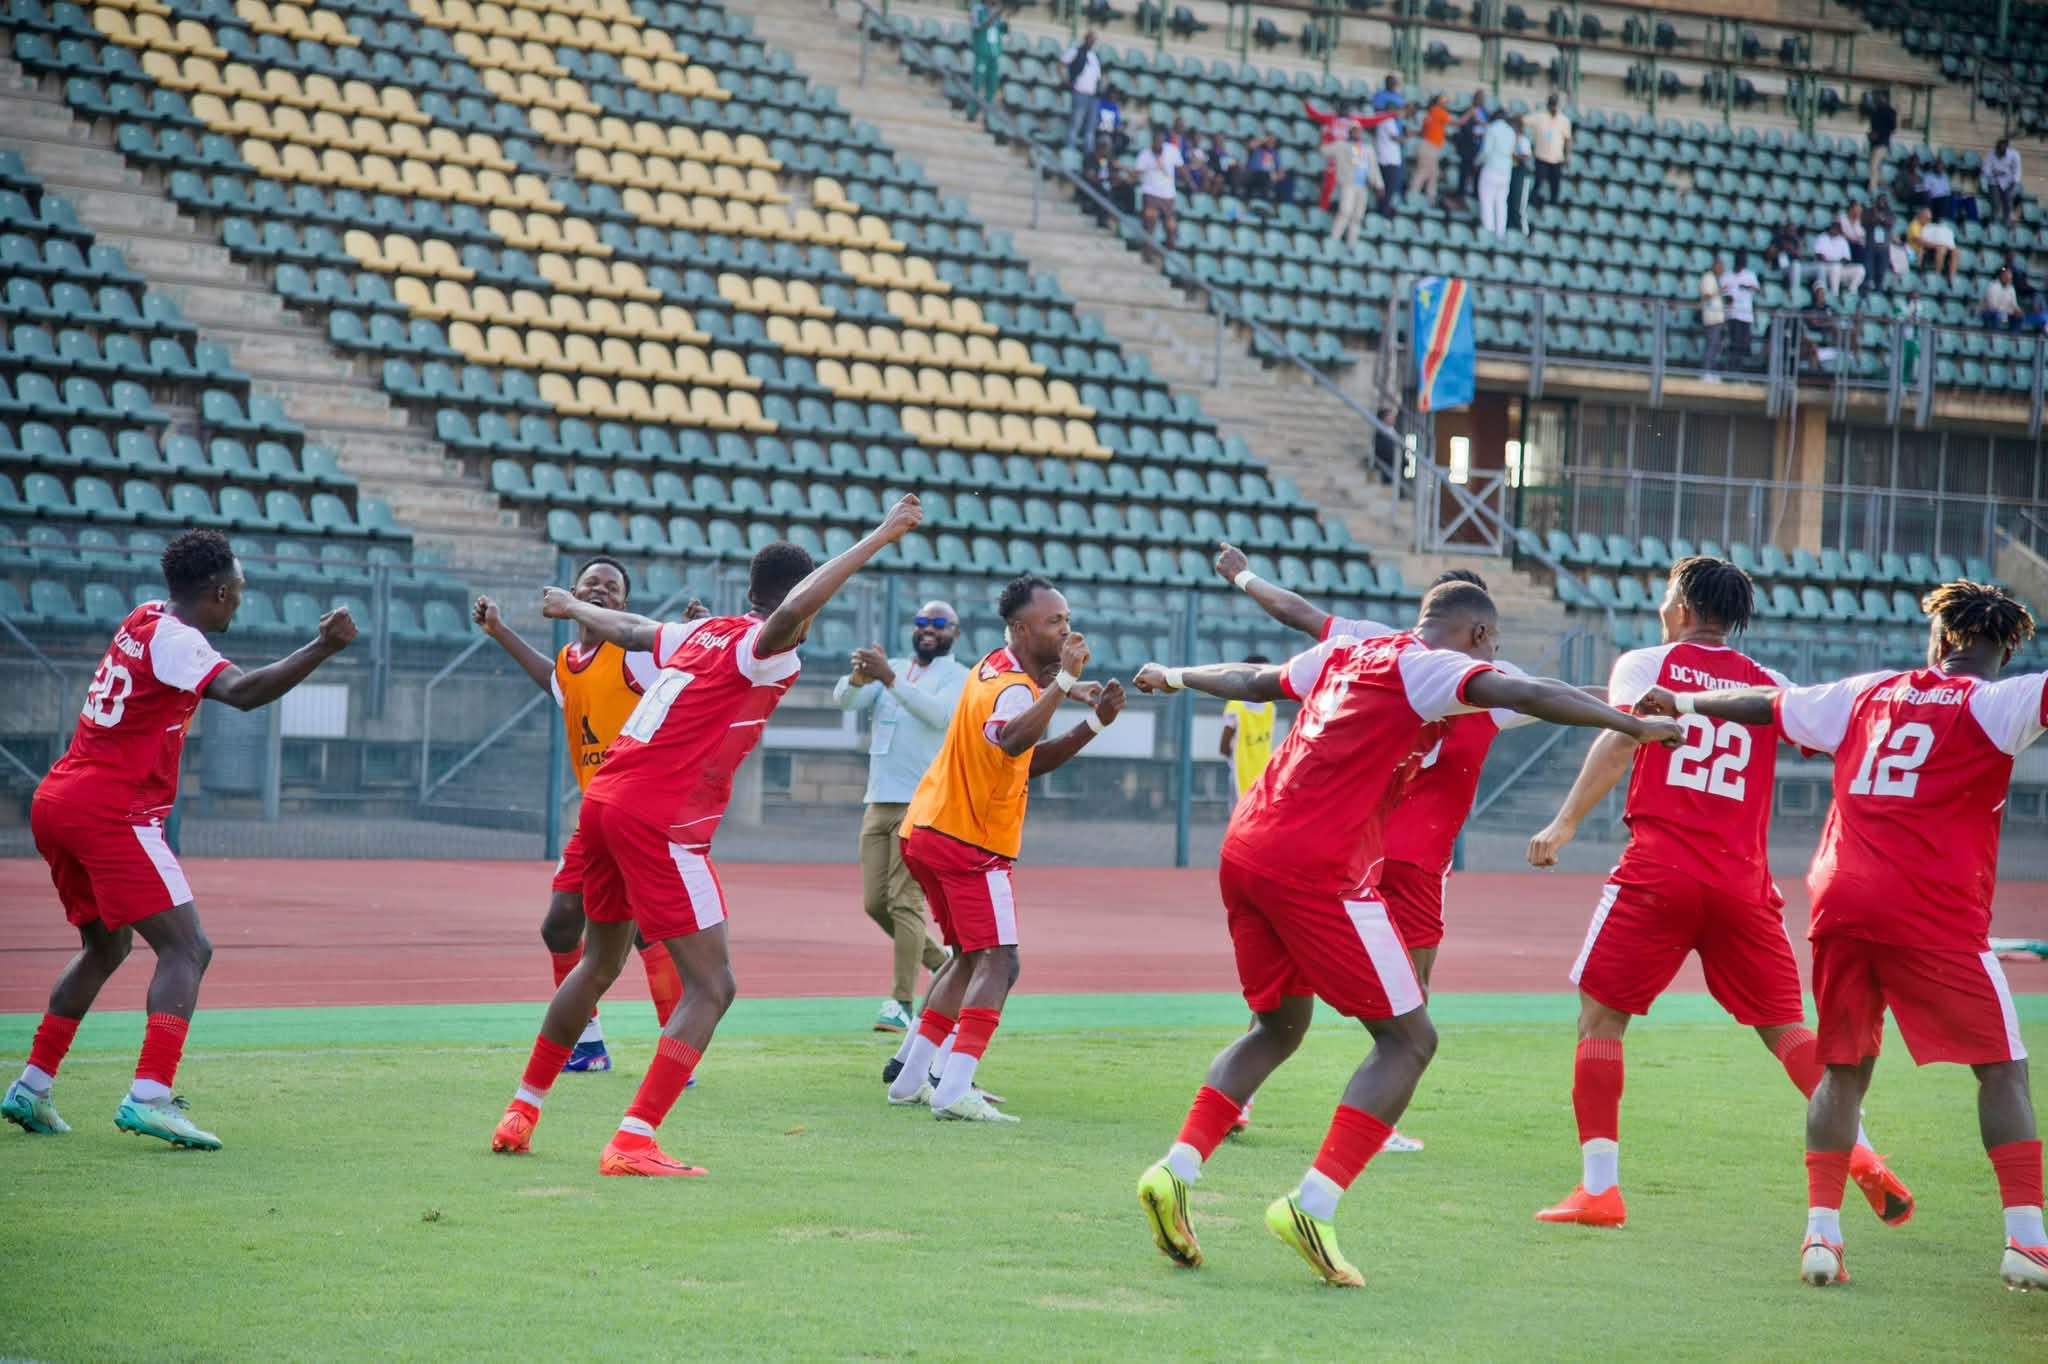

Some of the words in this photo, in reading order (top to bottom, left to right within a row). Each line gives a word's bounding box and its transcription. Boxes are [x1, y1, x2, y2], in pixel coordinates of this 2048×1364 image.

[81, 654, 133, 728] 20
[1670, 664, 1692, 683] DC
[1666, 713, 1752, 802] 22
[1848, 718, 1935, 798] 12
